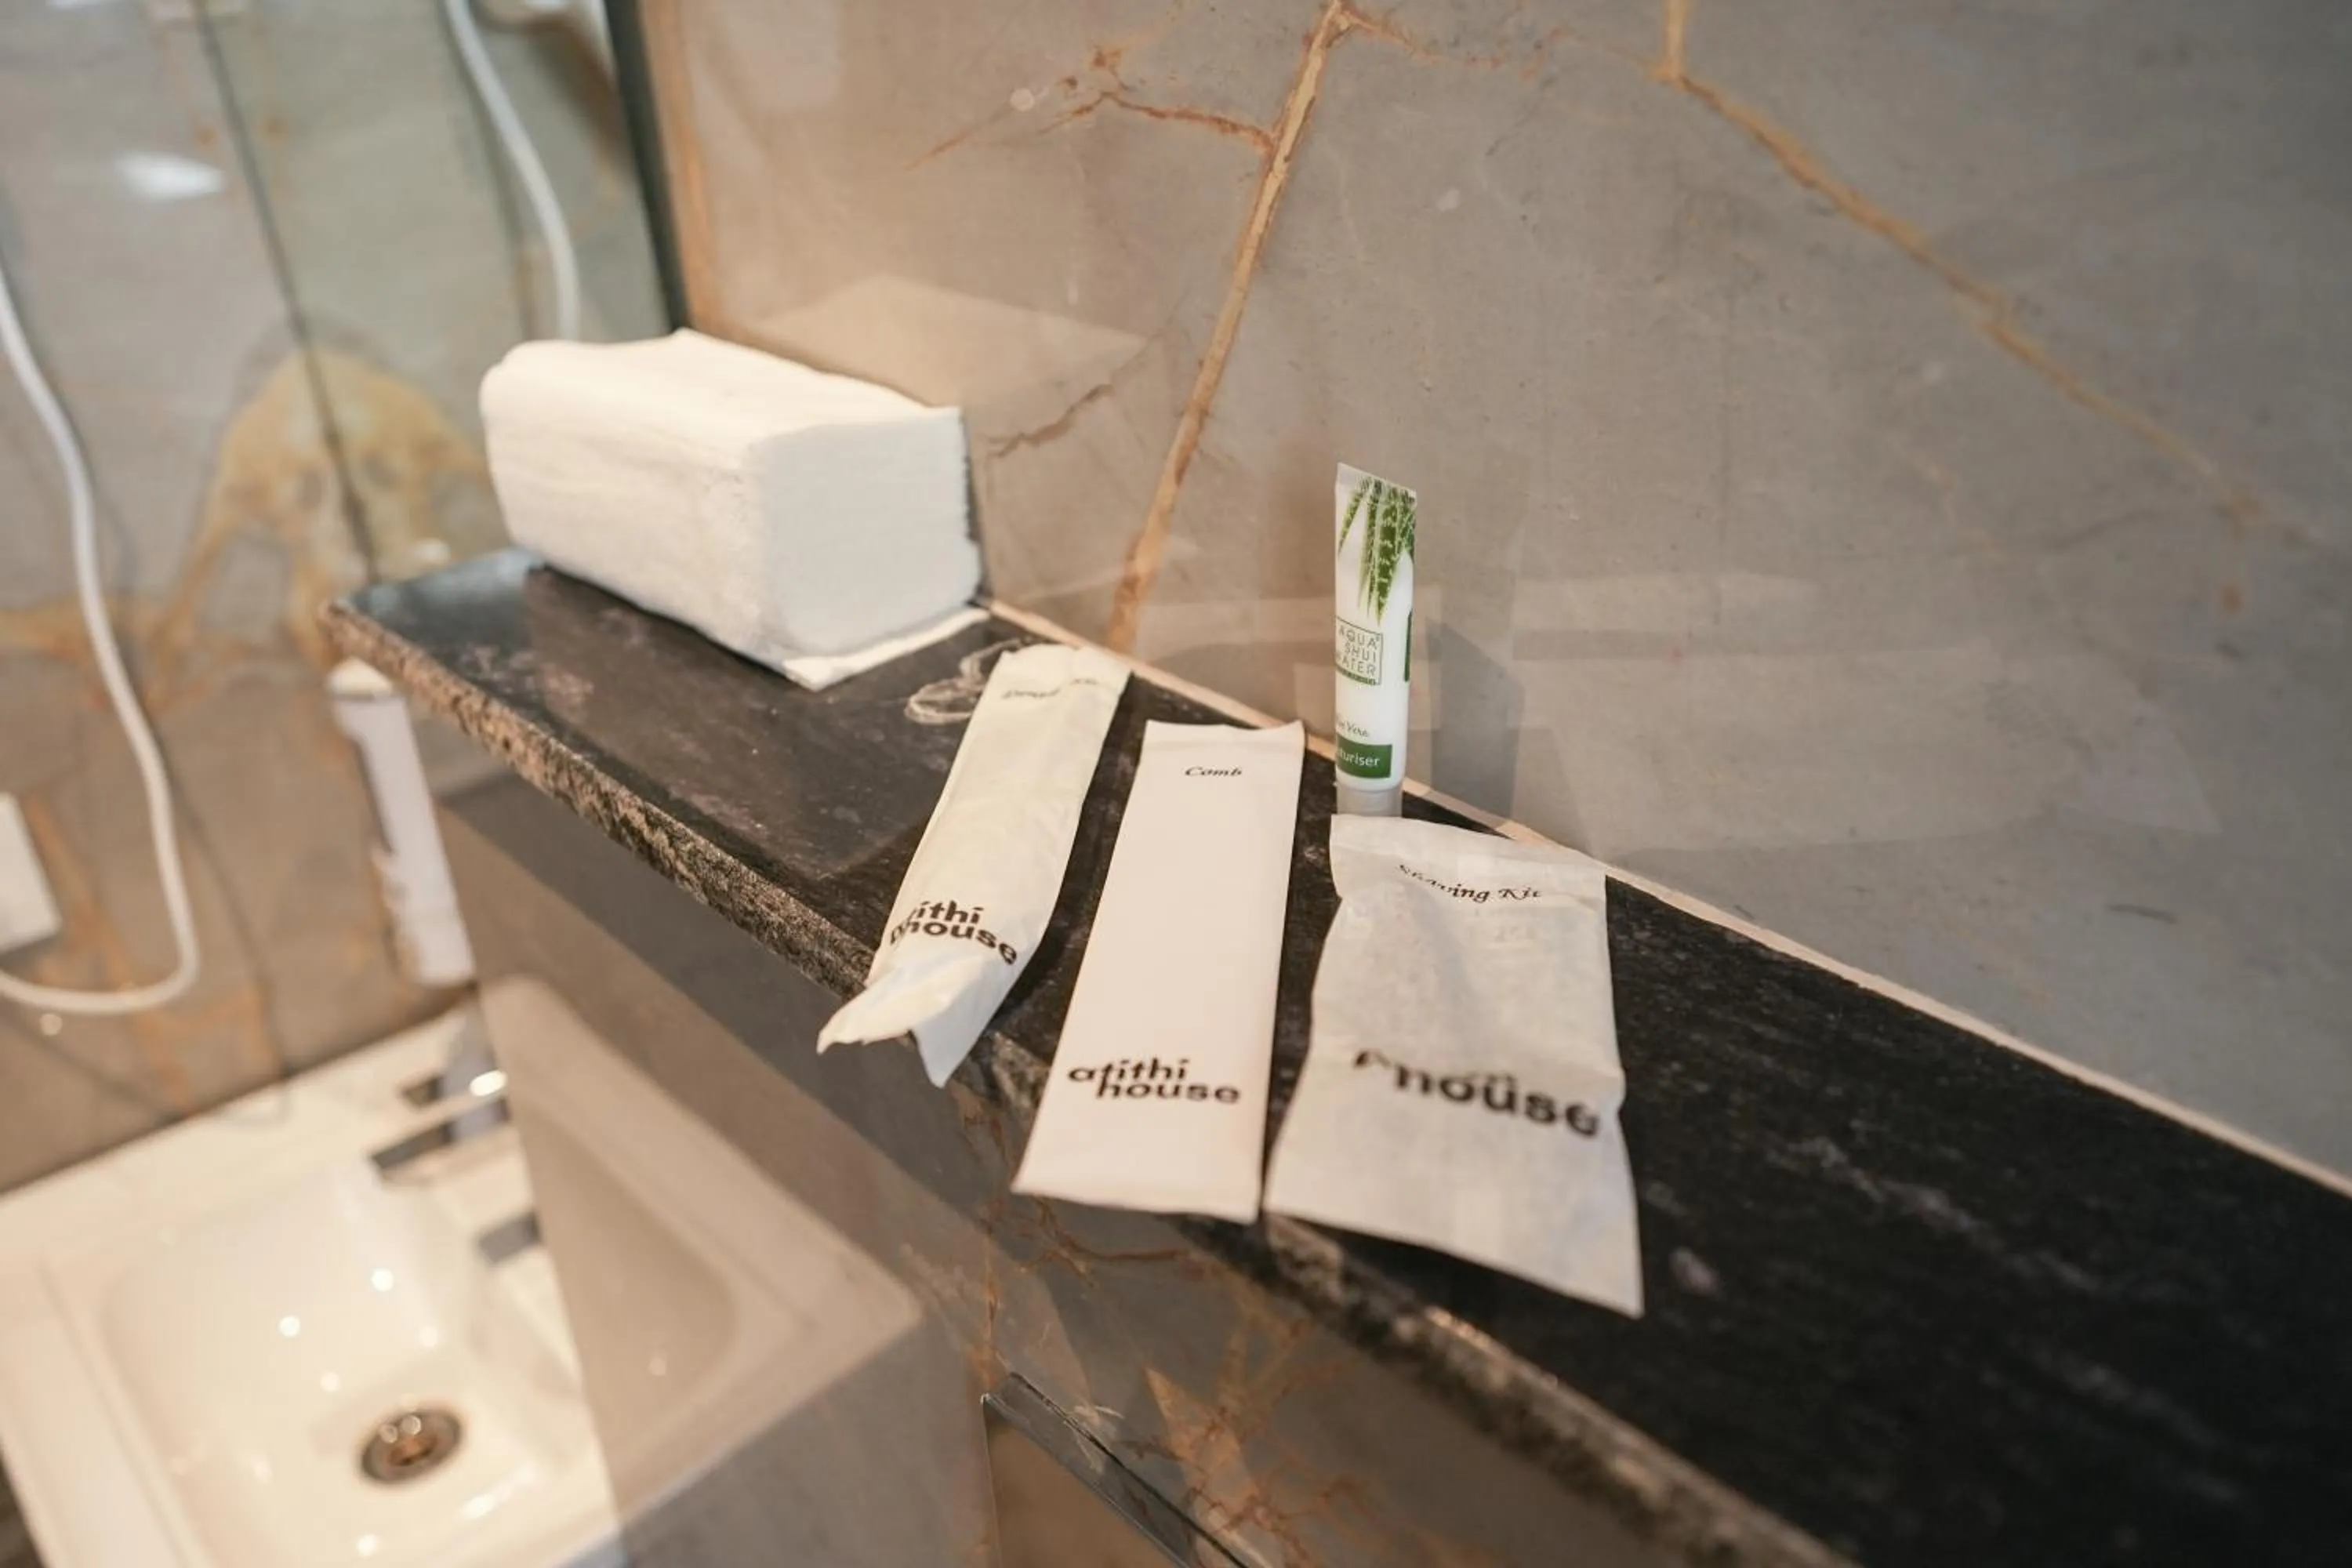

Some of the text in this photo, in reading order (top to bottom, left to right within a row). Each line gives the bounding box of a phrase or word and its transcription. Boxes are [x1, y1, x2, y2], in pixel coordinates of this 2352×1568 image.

[1338, 746, 1381, 767] turiser
[1185, 766, 1243, 777] Comb
[1097, 1081, 1240, 1103] house
